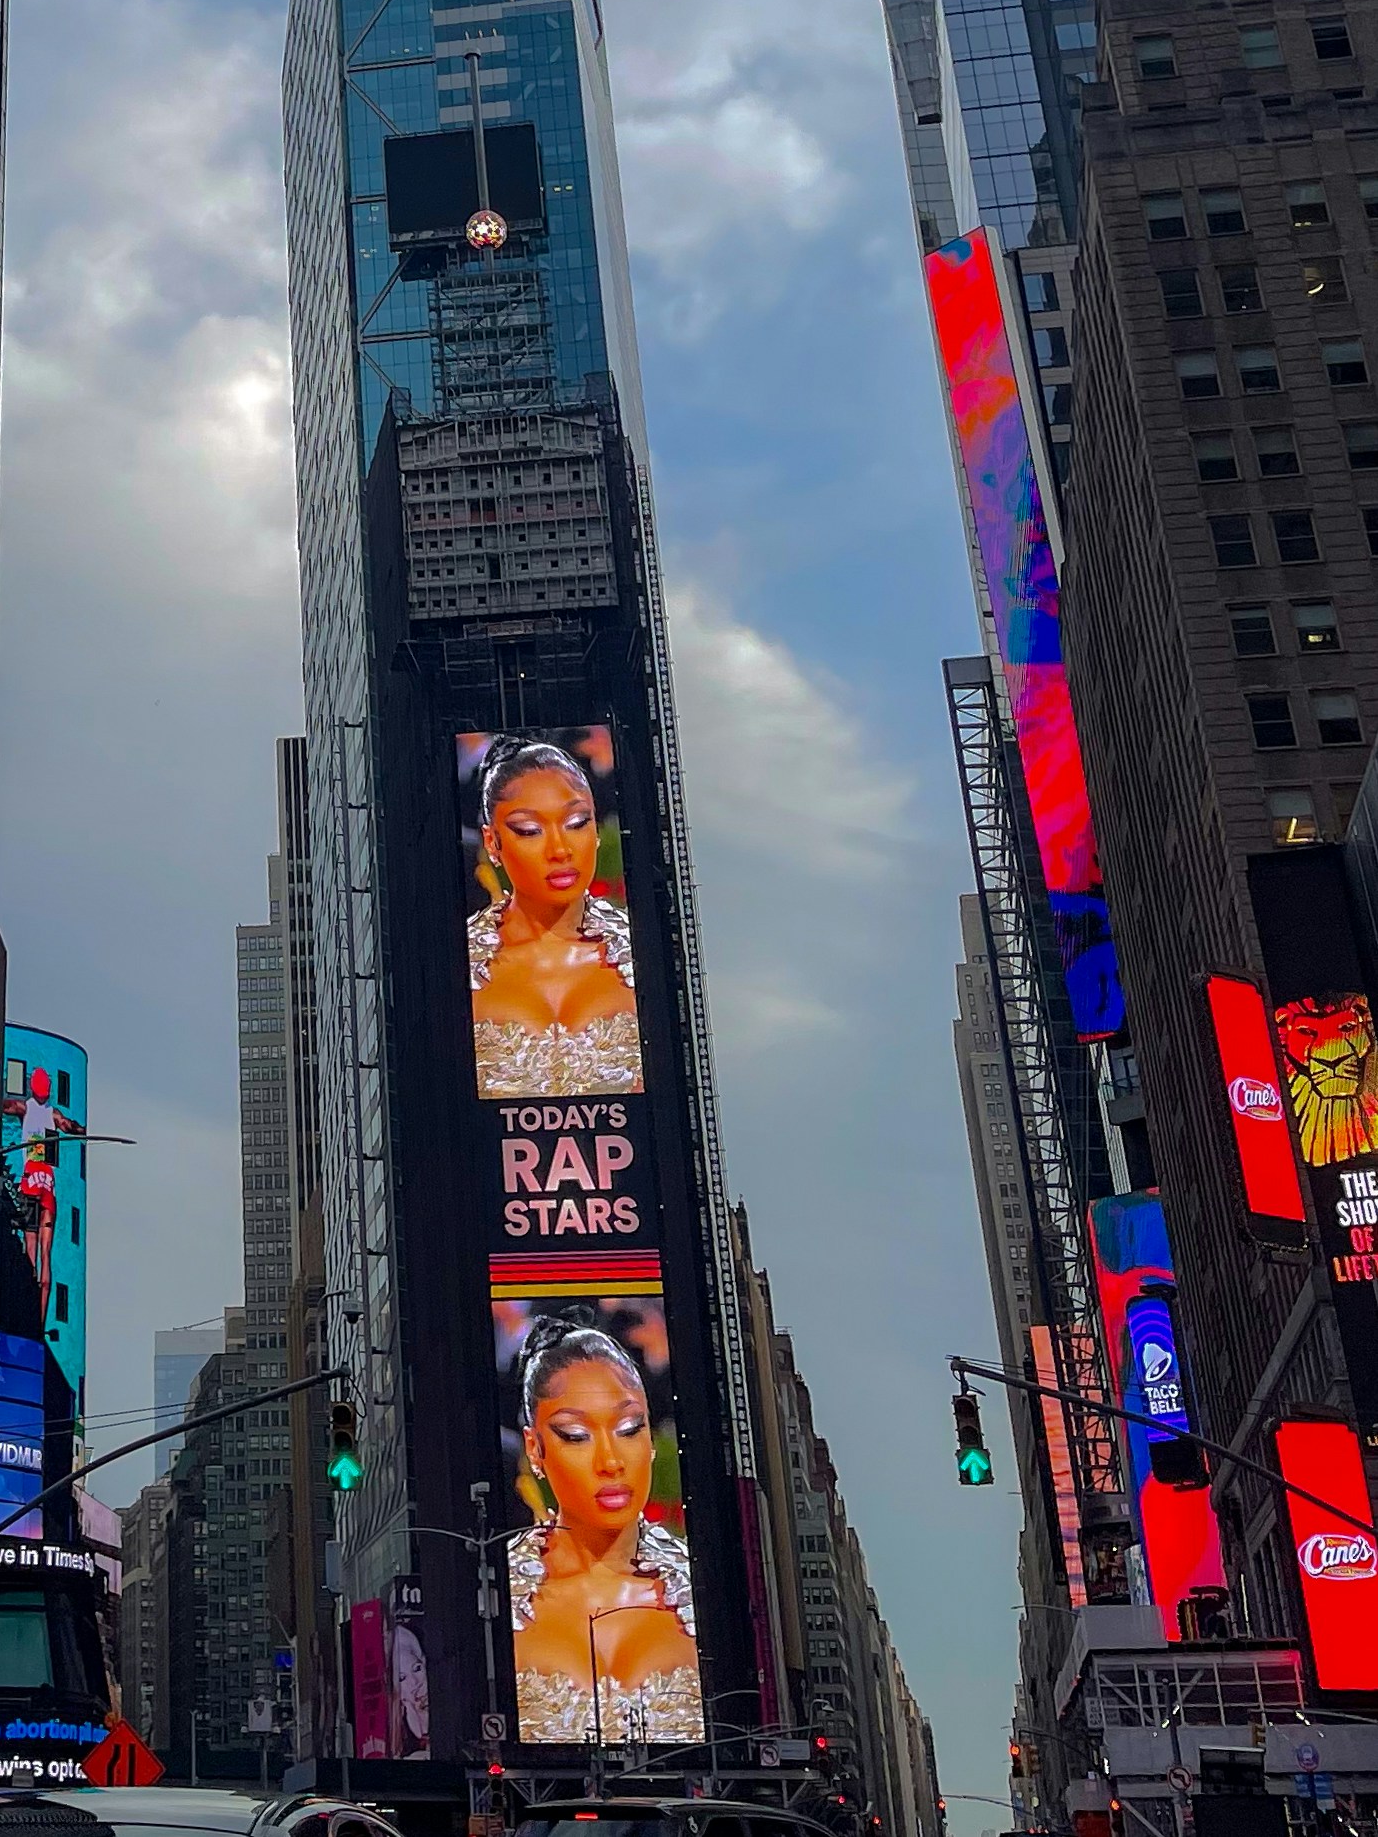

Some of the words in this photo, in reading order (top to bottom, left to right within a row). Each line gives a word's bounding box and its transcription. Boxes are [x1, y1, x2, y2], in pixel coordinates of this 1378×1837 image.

[1231, 1077, 1277, 1112] Cane's
[500, 1103, 627, 1132] TODAY'S
[502, 1135, 634, 1193] RAP
[1339, 1171, 1378, 1198] THE
[504, 1196, 640, 1237] STARS
[1336, 1199, 1378, 1227] SHO
[1350, 1226, 1374, 1253] OF
[1144, 1384, 1179, 1400] TACO
[1150, 1398, 1182, 1415] BELL
[20, 1546, 38, 1566] in
[43, 1546, 84, 1570] Times
[1305, 1535, 1373, 1575] Cane's
[6, 1719, 78, 1741] abortion
